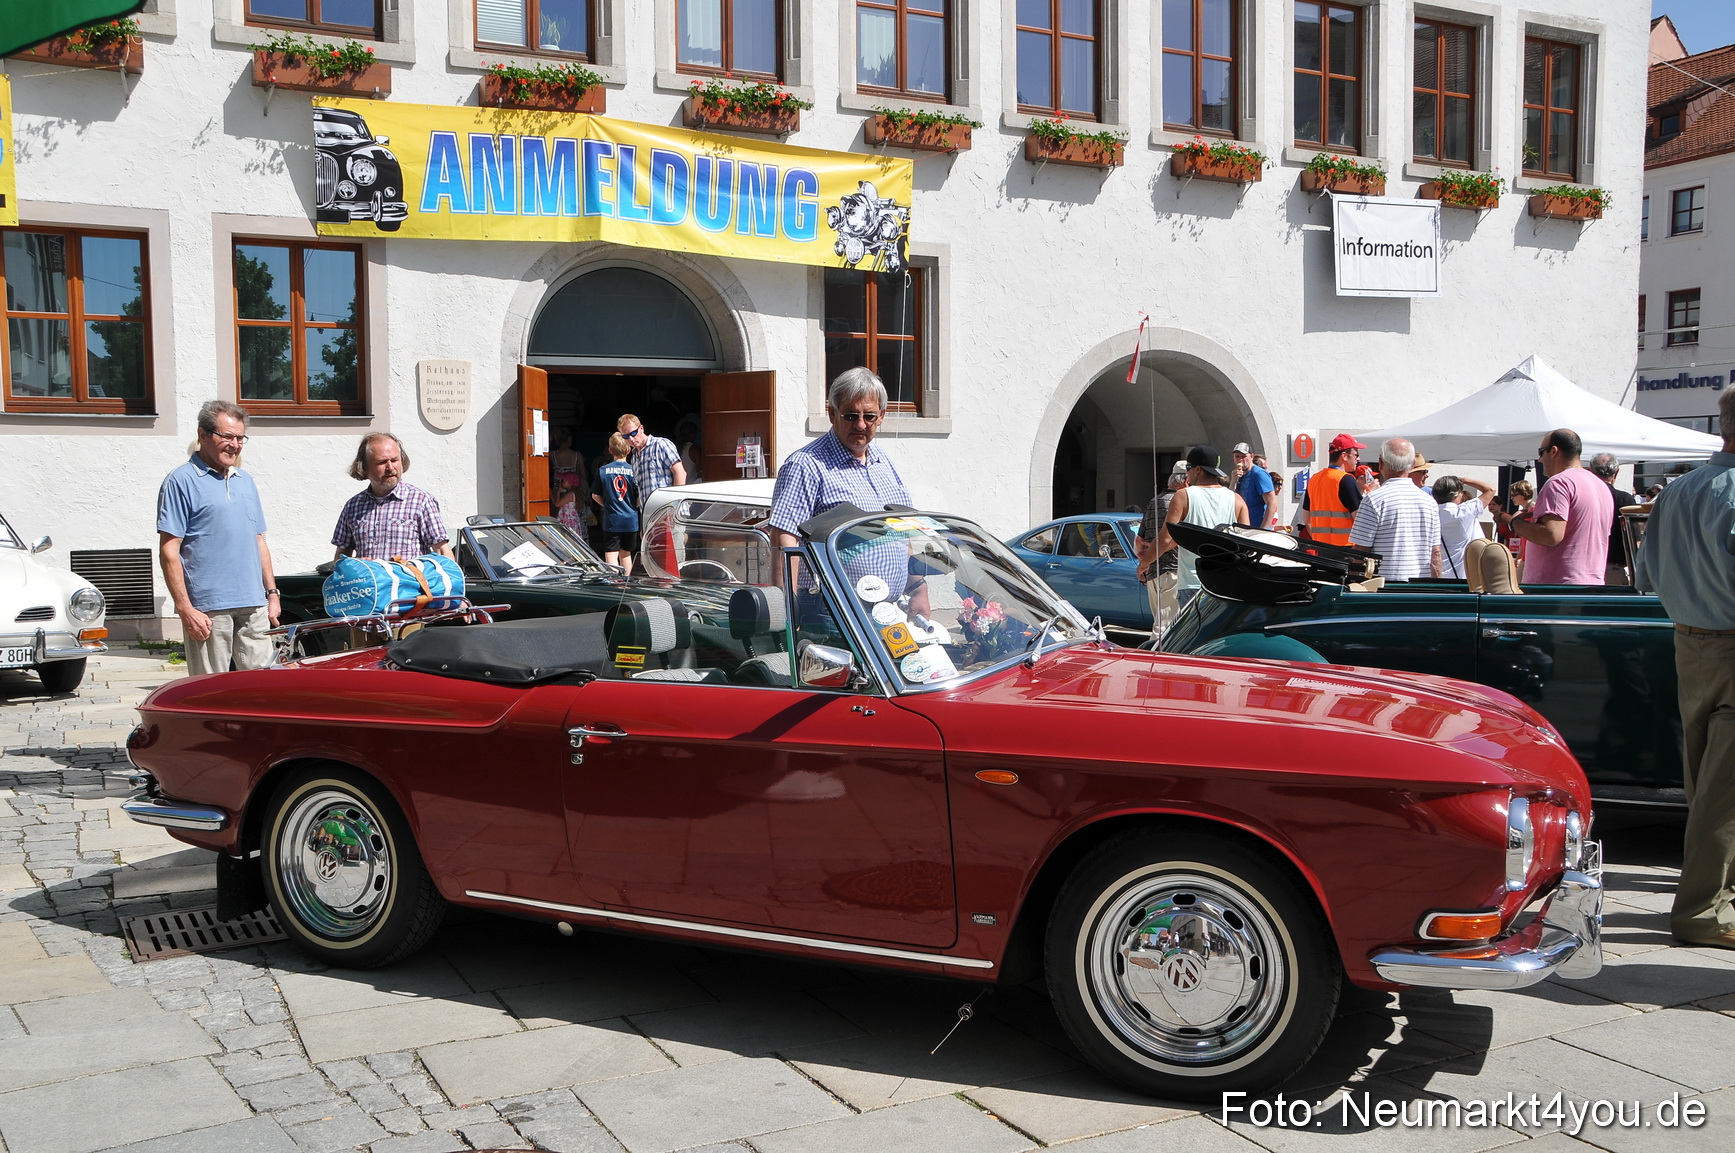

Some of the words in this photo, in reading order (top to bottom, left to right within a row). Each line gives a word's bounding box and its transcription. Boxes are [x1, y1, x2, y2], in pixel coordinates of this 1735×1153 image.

[420, 130, 820, 241] ANMELDUNG
[1342, 236, 1433, 259] Information
[426, 365, 465, 374] Rathaus
[613, 475, 628, 501] 9
[7, 648, 33, 663] 80H
